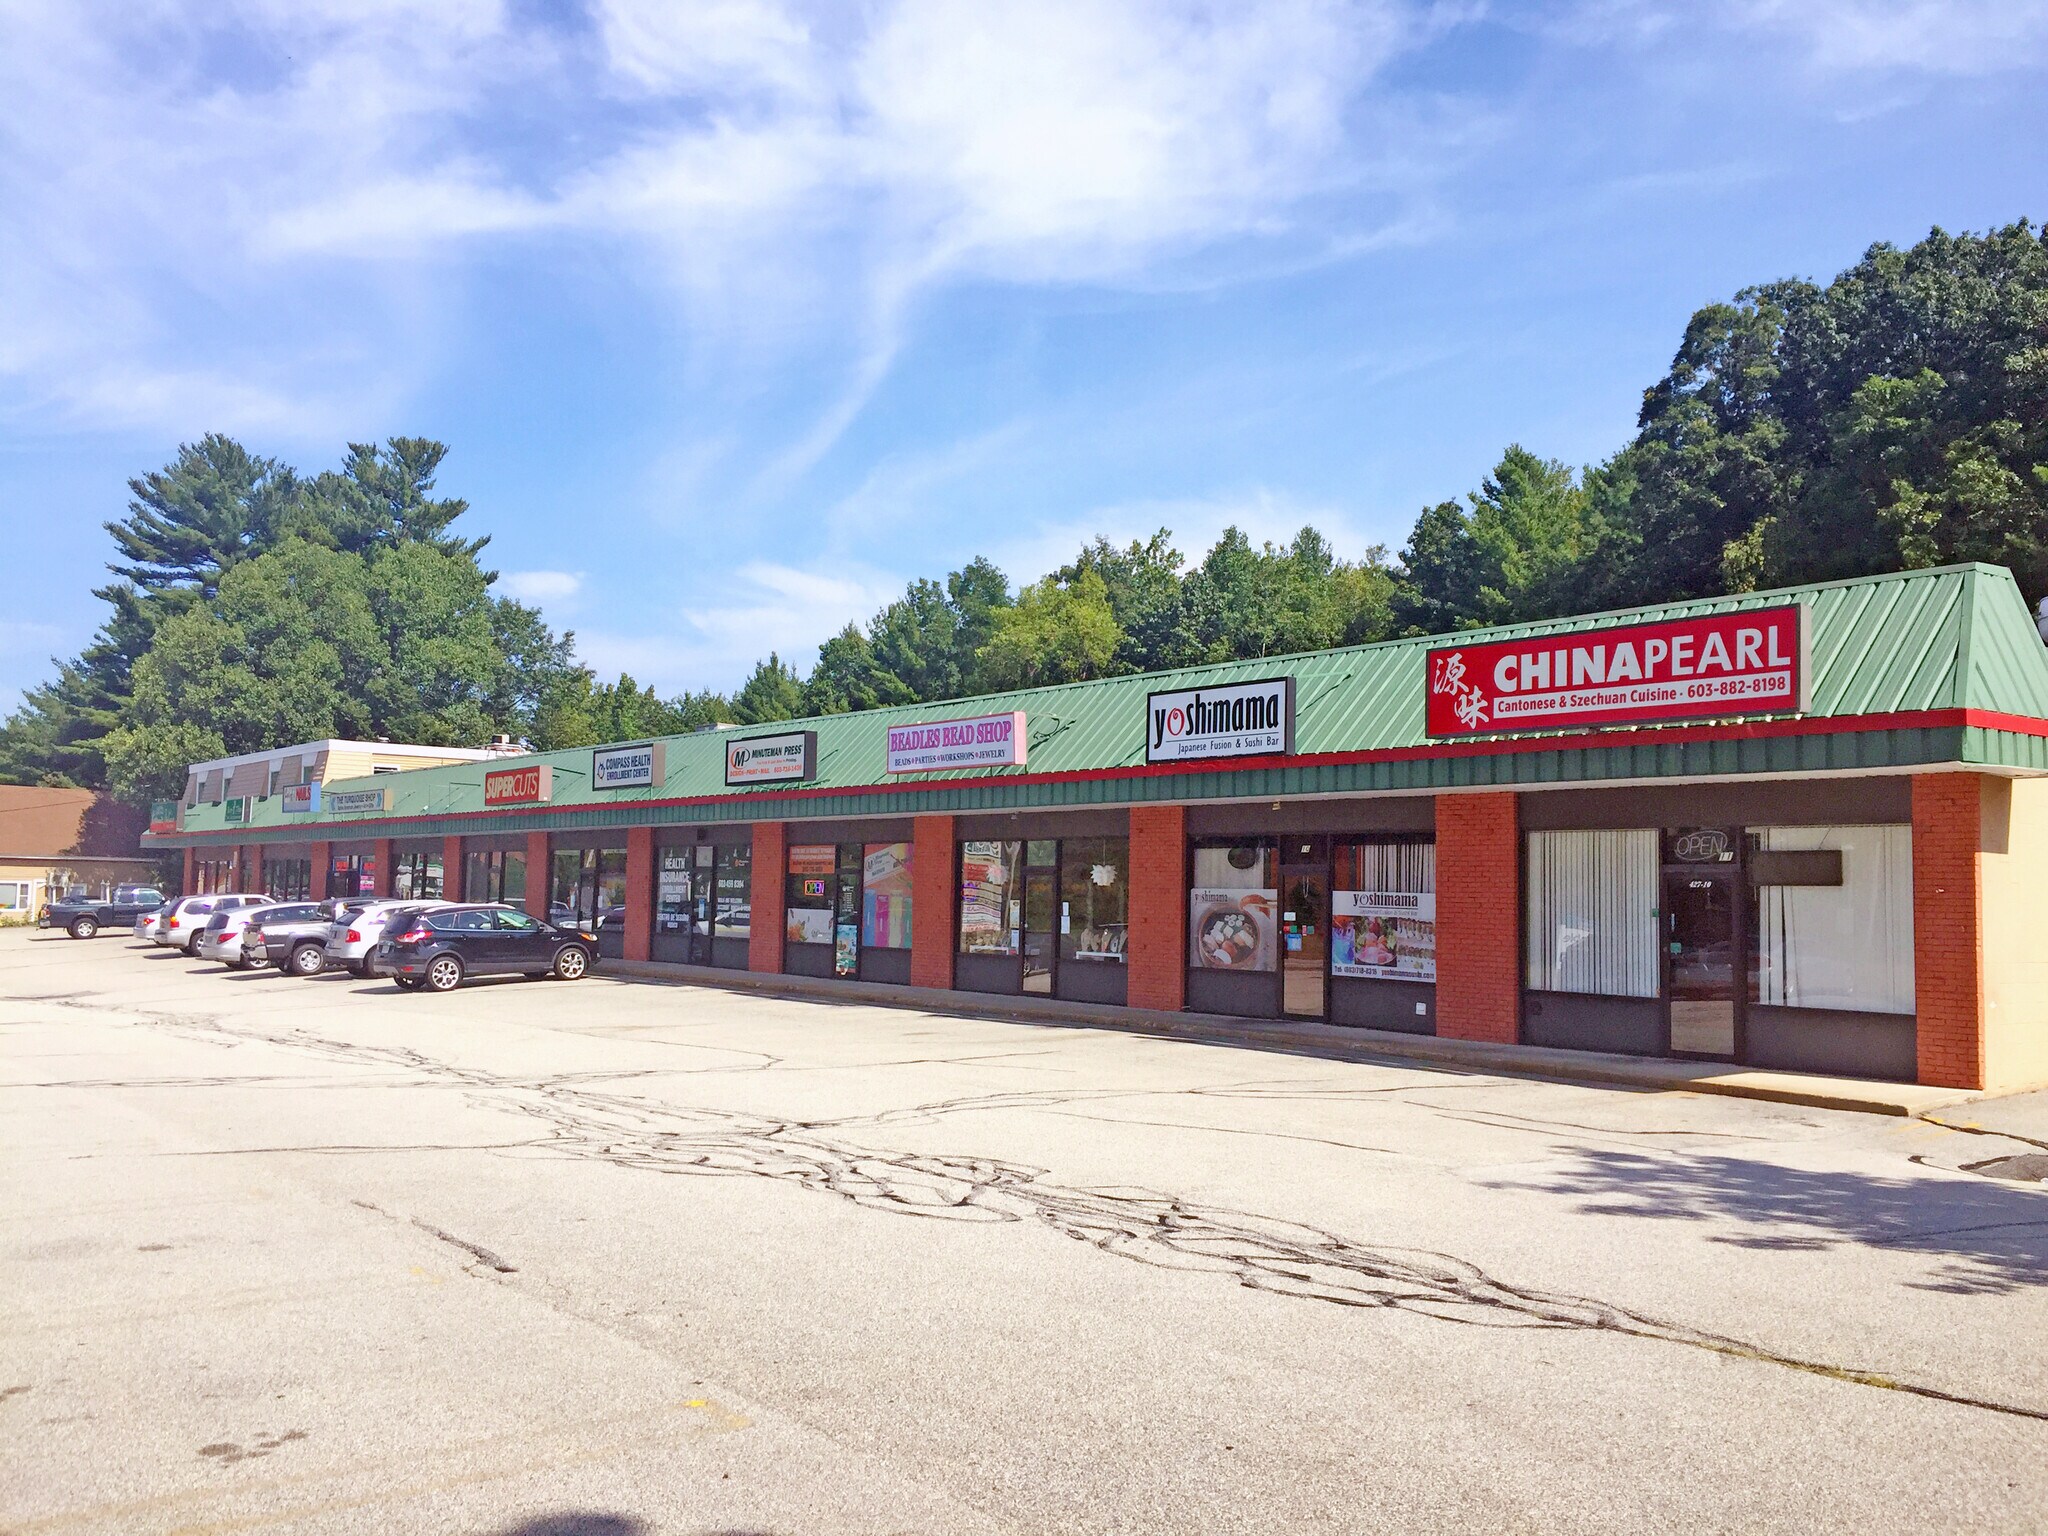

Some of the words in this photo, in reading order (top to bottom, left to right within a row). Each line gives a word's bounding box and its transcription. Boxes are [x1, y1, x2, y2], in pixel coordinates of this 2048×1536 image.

[1498, 697, 1556, 713] Cantonese
[1559, 697, 1567, 708] &
[1570, 691, 1627, 707] Szechuan
[1630, 687, 1677, 703] Cuisine
[1687, 677, 1787, 698] 603-882-8198
[1154, 694, 1279, 749] yoshimama
[890, 728, 940, 752] BEADLES
[942, 724, 975, 747] BEAD
[977, 720, 1011, 744] SHOP
[752, 747, 782, 758] MINUTEMAN
[784, 745, 802, 755] PRESS
[1178, 743, 1206, 755] Japanese
[1210, 740, 1231, 750] Fusion
[1235, 738, 1241, 747] &
[1245, 737, 1263, 747] Sushi
[1267, 736, 1279, 746] Bar
[605, 756, 630, 770] COMPASS
[631, 754, 651, 767] HEALTH
[894, 757, 911, 766] BEADS
[915, 755, 936, 764] PARTIES
[940, 752, 975, 762] WORKSHOPS
[979, 749, 1005, 759] JEWELRY
[606, 769, 632, 780] ENROLLMENT
[633, 768, 649, 778] CENTER
[486, 772, 538, 799] SUPERCUTS
[1677, 835, 1724, 855] OPEN
[664, 858, 686, 870] HEALTH
[806, 881, 825, 894] OPEN
[1353, 892, 1418, 908] yoshimama
